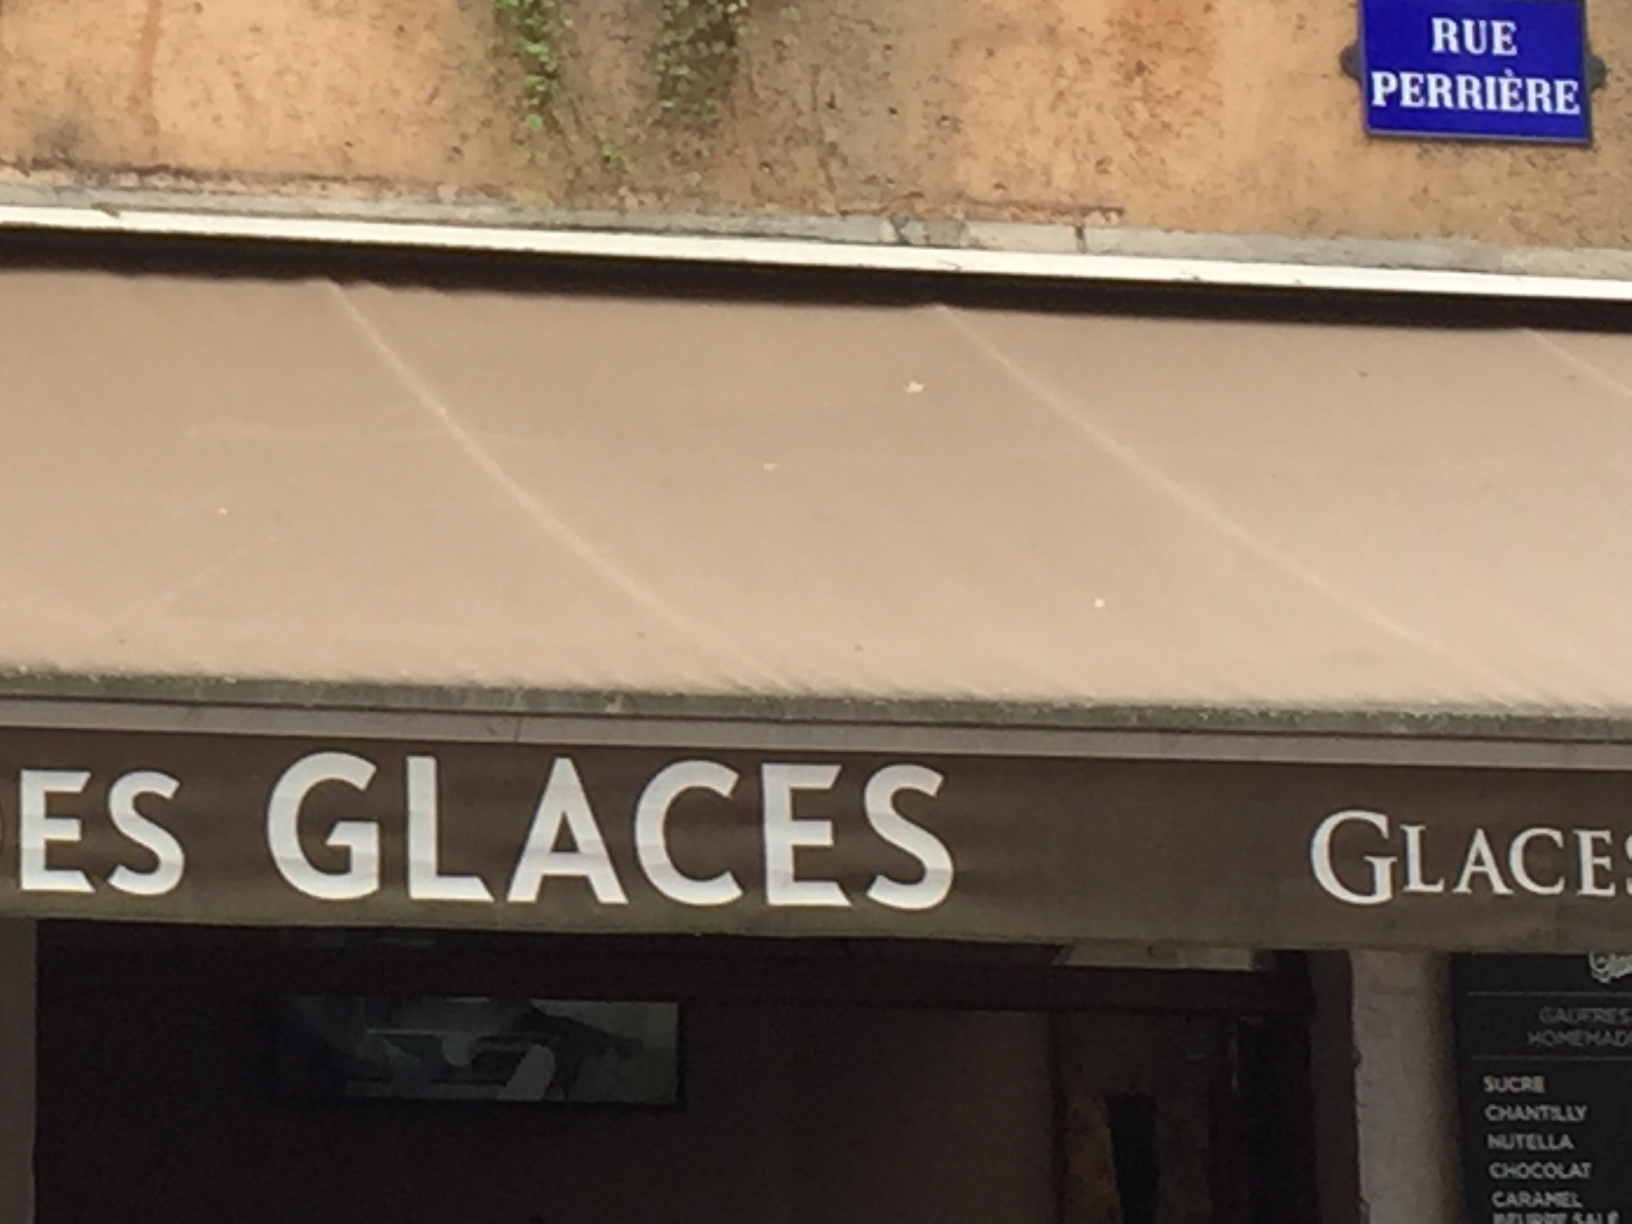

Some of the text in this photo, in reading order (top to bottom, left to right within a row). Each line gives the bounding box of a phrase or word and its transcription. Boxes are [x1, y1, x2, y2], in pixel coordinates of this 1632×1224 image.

[1431, 16, 1518, 56] RUE
[1370, 68, 1581, 116] PERRIÈRE
[267, 752, 954, 910] GLACES
[1483, 1076, 1546, 1094] SUCRE
[1484, 1104, 1588, 1122] CHANTILLY
[1487, 1133, 1575, 1151] NUTELLA
[1489, 1161, 1593, 1180] CHOCOLAT
[1491, 1190, 1584, 1209] CARAMEL
